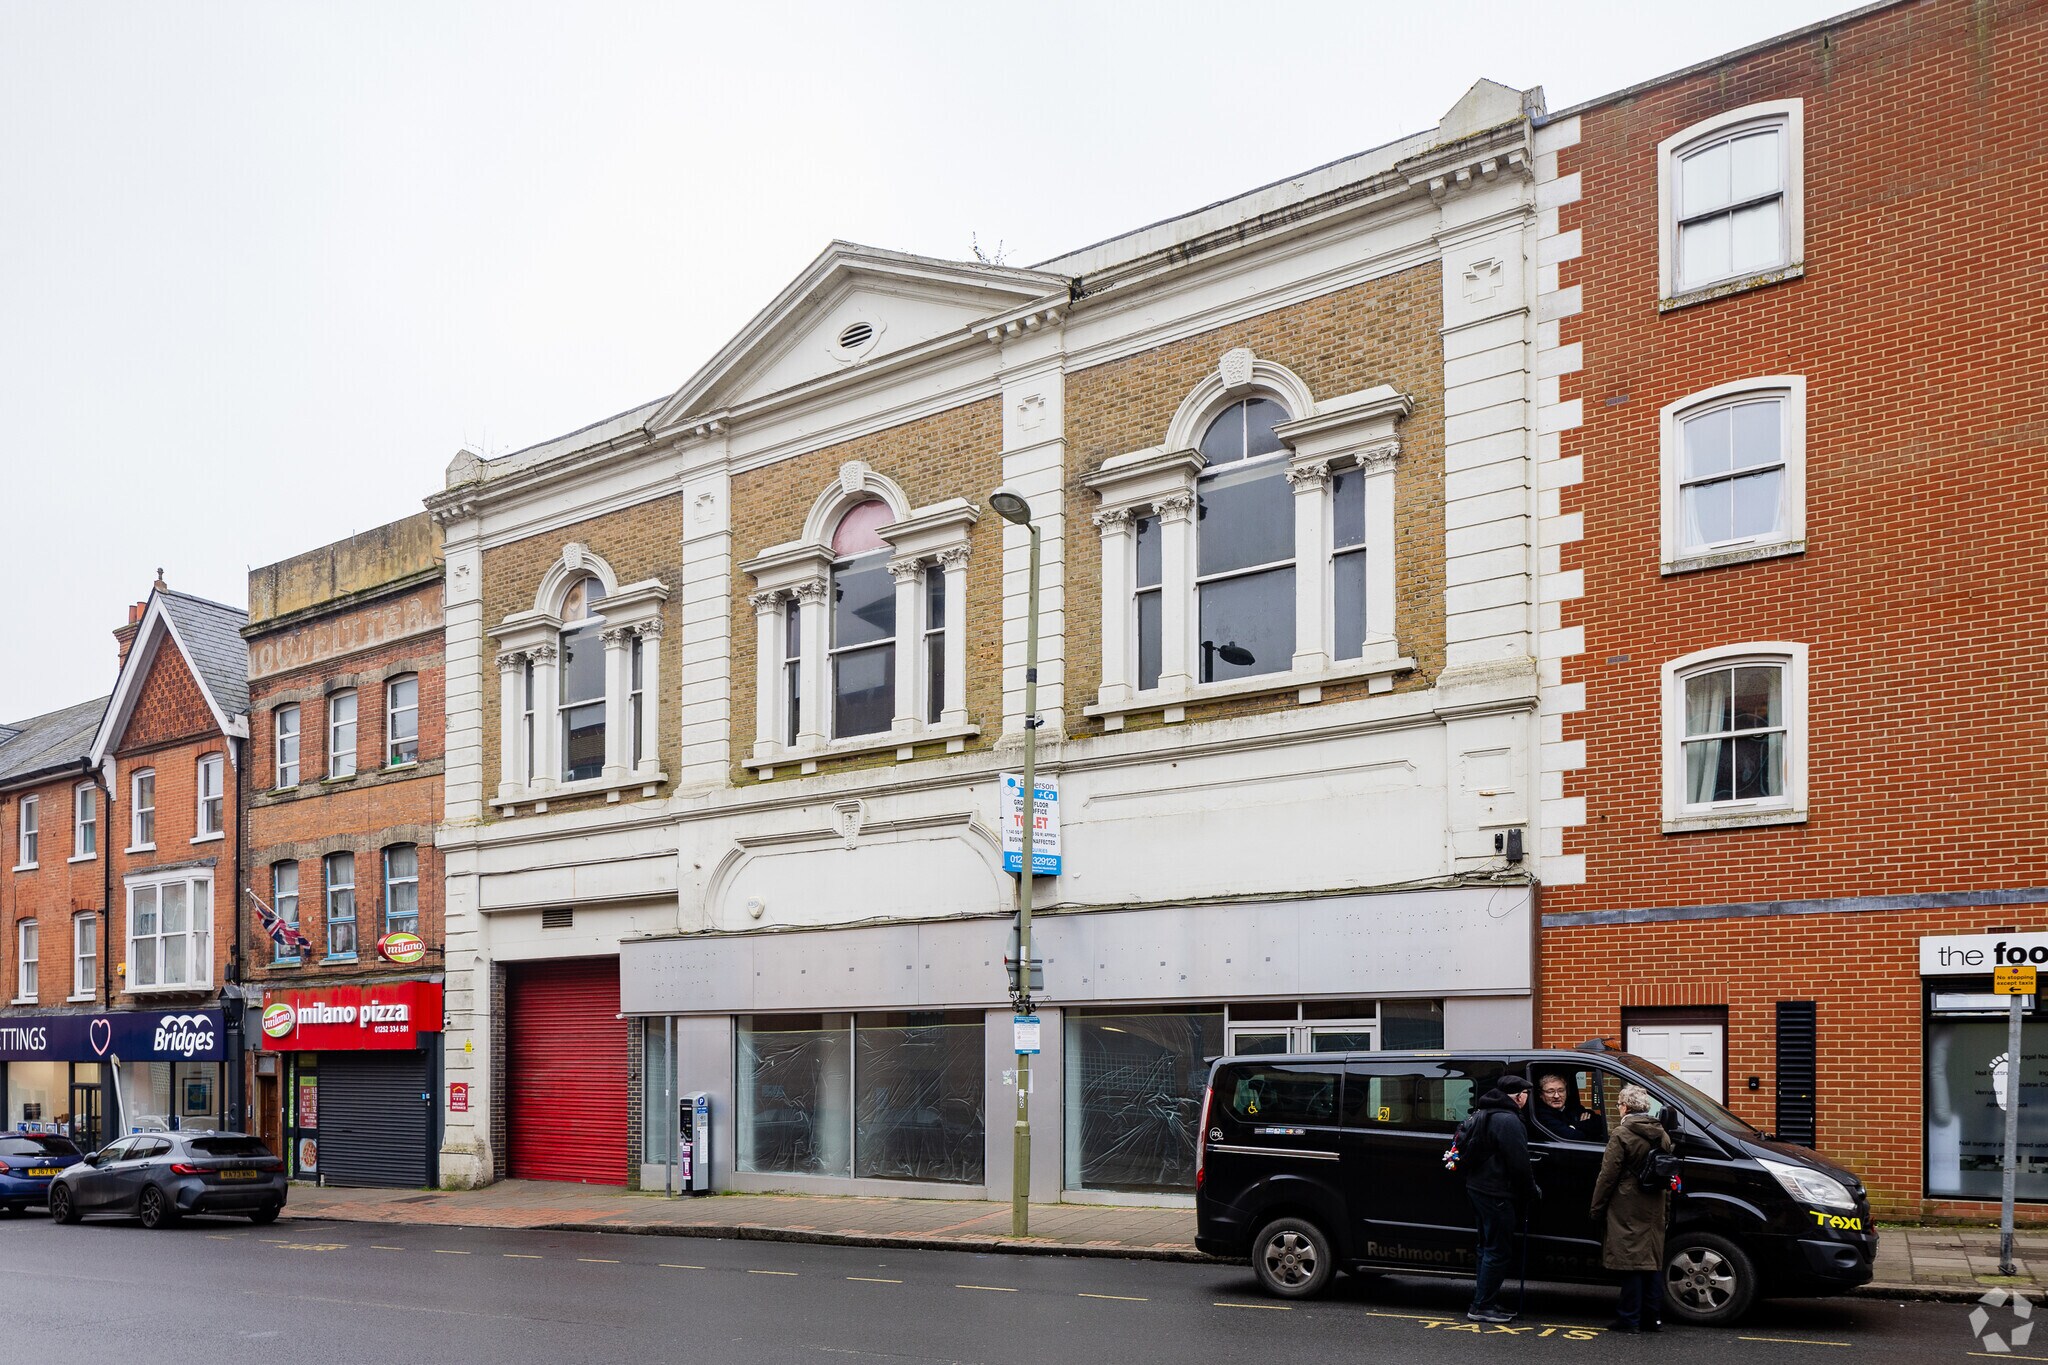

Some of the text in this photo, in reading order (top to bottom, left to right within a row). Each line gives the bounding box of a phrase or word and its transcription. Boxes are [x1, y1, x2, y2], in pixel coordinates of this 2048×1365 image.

[1020, 779, 1054, 790] Eerson
[1038, 791, 1054, 800] +Co
[387, 942, 422, 954] milano
[1938, 946, 1984, 966] the
[265, 1012, 290, 1029] milano
[298, 1000, 409, 1028] milano pizza
[153, 1024, 215, 1057] Bridges
[1809, 1210, 1861, 1230] TAXI
[1367, 1241, 1451, 1261] Rushmoor
[1418, 1320, 1599, 1340] TAXIS
